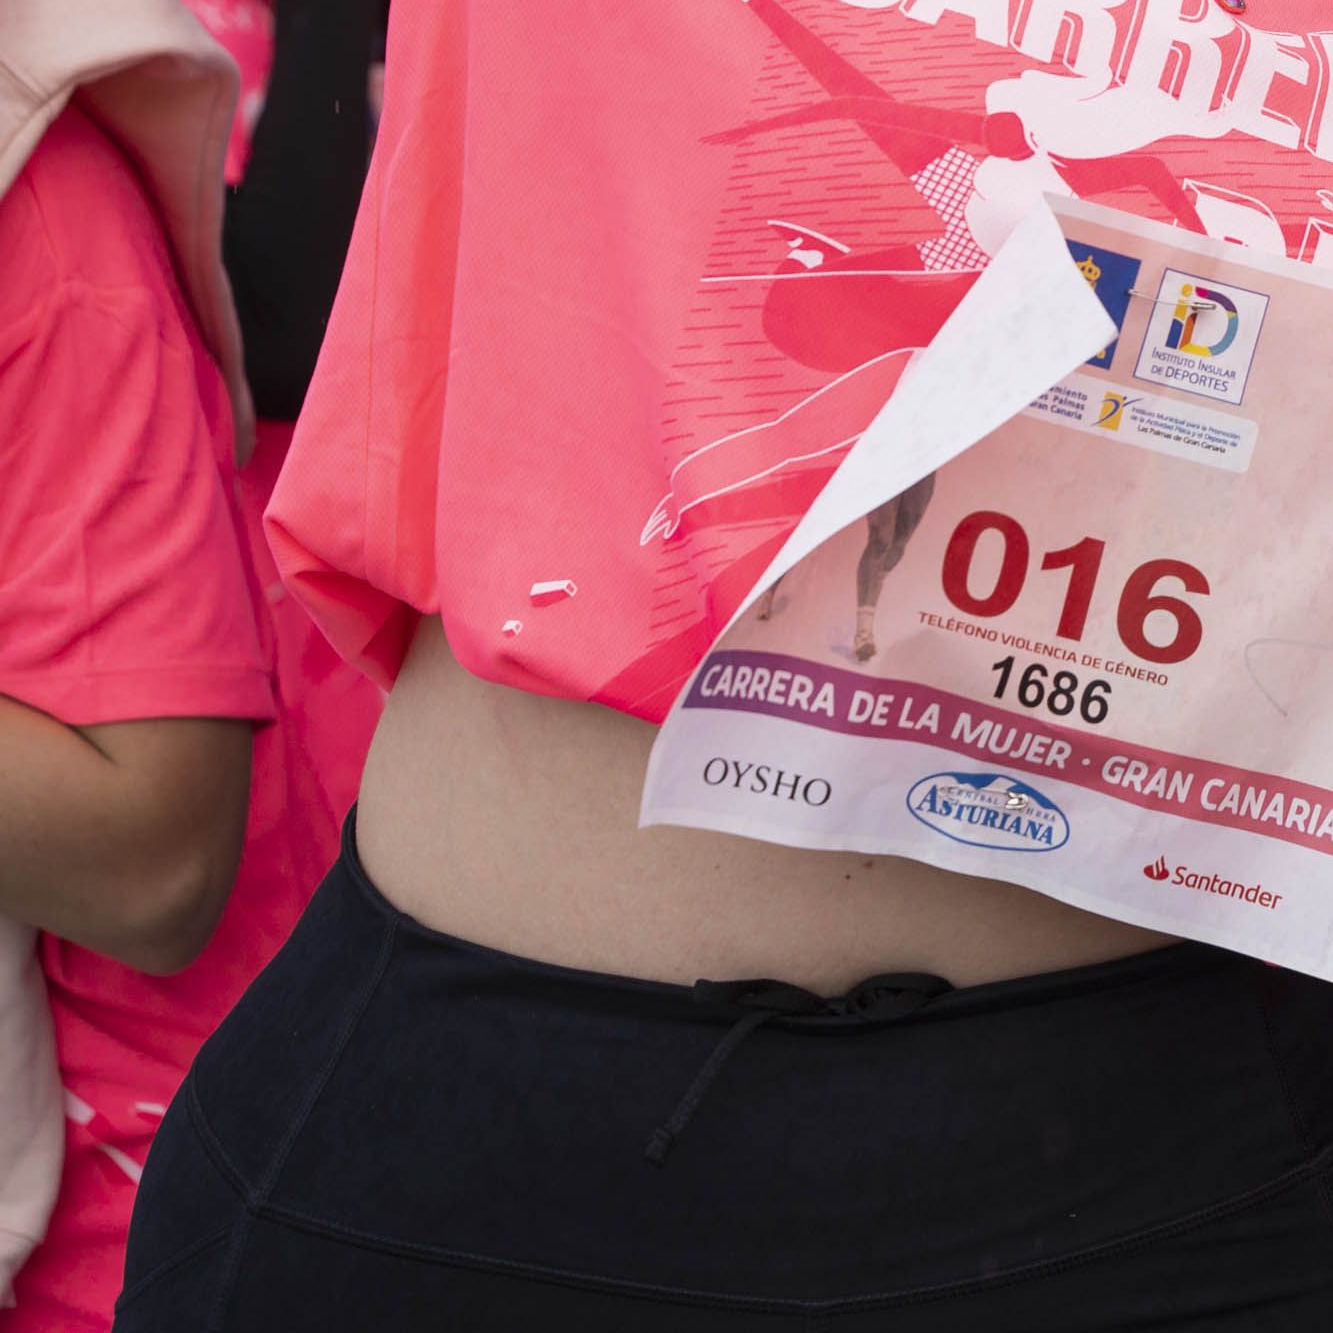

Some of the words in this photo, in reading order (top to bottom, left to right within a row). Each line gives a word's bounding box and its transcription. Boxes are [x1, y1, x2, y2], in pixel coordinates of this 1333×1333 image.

[1053, 395, 1085, 411] Palmas
[1165, 366, 1229, 393] DEPORTES
[1050, 404, 1083, 421] Canaria
[941, 510, 1210, 664] 016
[919, 611, 998, 642] TELÉFONO
[1001, 632, 1078, 664] VIOLENCIA
[1081, 654, 1101, 669] DE
[1104, 660, 1169, 686] GÉNERO
[992, 655, 1112, 724] 1686
[700, 664, 836, 718] CARRERA
[847, 690, 889, 727] DE
[898, 697, 939, 733] LA
[950, 712, 1073, 769] MUJER
[1102, 755, 1194, 803] GRAN
[702, 756, 832, 807] OYSHO
[916, 783, 1054, 845] ASTURIANA
[1171, 865, 1283, 909] Santander
